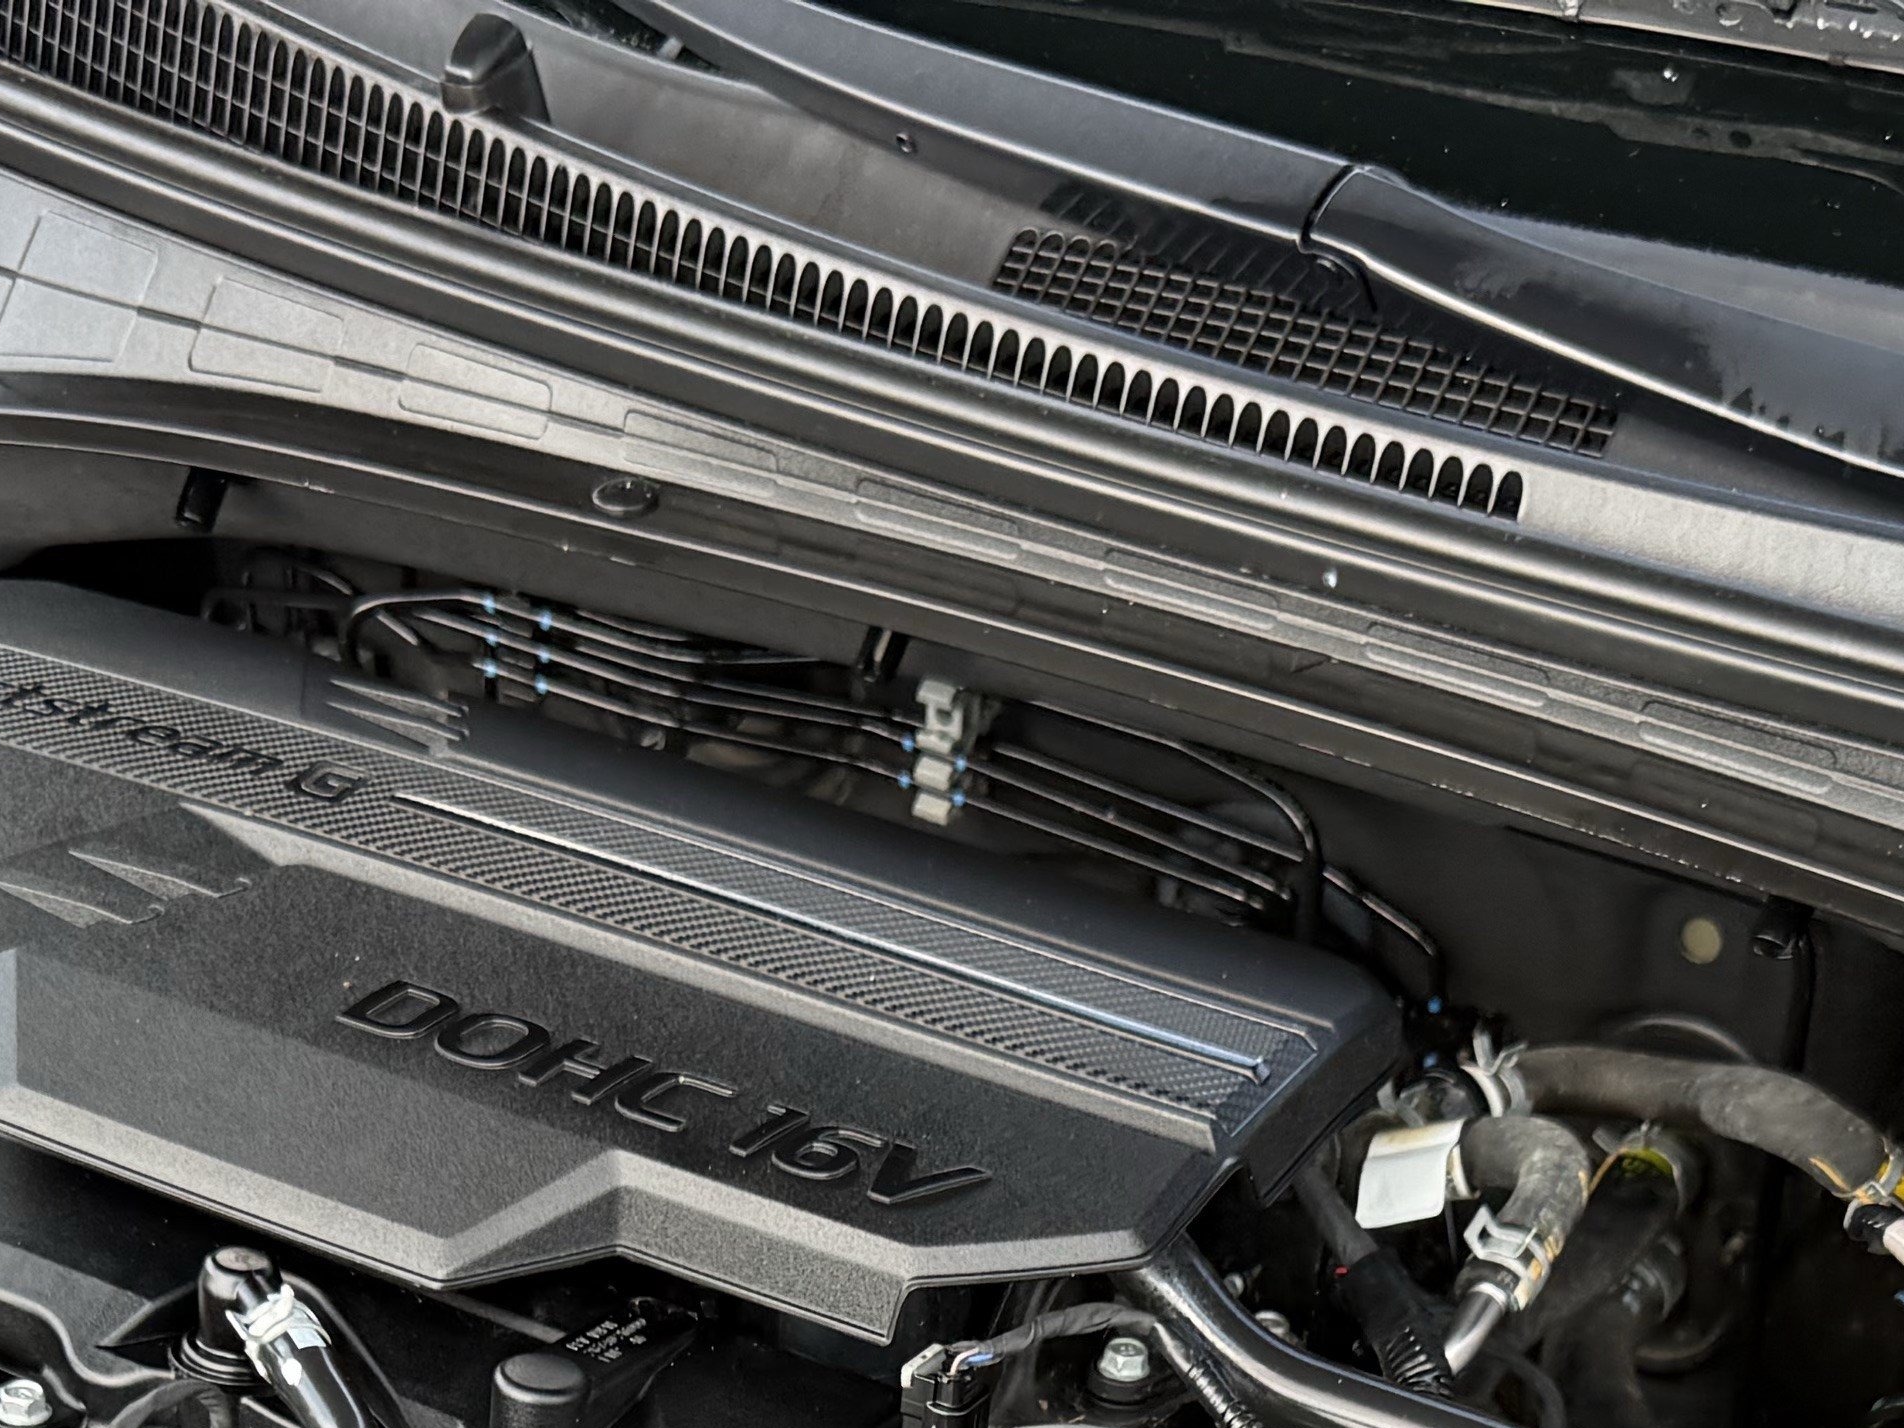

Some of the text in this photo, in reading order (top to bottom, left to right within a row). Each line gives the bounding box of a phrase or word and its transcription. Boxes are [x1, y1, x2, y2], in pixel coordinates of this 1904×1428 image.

[282, 752, 364, 806] G
[342, 978, 992, 1207] DOHC 16V
